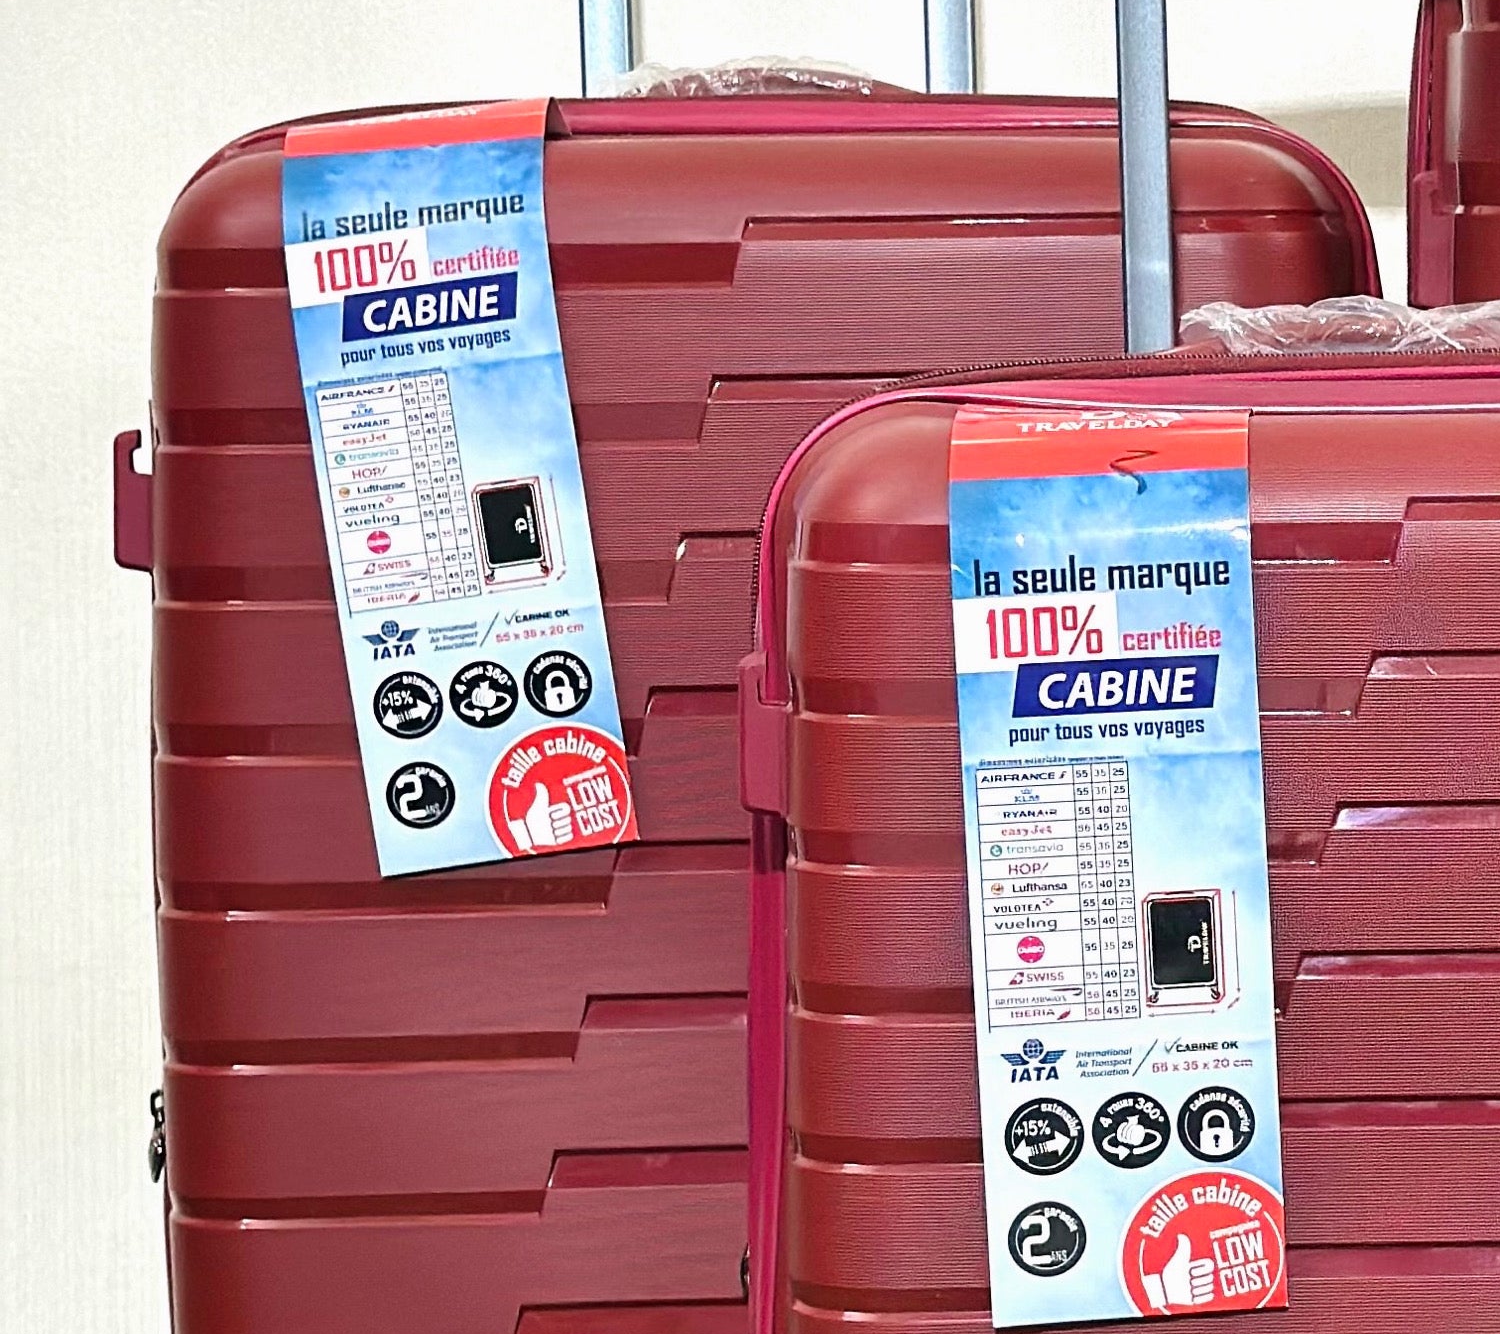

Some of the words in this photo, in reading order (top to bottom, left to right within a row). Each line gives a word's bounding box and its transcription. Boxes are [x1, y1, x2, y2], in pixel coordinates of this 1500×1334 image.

[303, 211, 326, 242] la
[336, 201, 408, 237] seule
[418, 193, 525, 227] marque
[314, 239, 416, 293] 100%
[433, 245, 520, 278] certifiée
[362, 284, 500, 333] CABINE
[340, 347, 376, 369] pour
[381, 342, 414, 359] tous
[418, 339, 445, 354] vos
[450, 329, 511, 353] voyages
[1017, 418, 1174, 433] TRAVELDAY
[974, 559, 1001, 596] la
[1013, 554, 1096, 594] seule
[1107, 560, 1230, 595] marque
[986, 604, 1102, 659] 100%
[1122, 620, 1222, 652] certifiée
[373, 643, 416, 661] IATA
[1038, 666, 1197, 710] CABINE
[1009, 726, 1050, 747] pour
[1055, 722, 1093, 740] tous
[1098, 724, 1128, 738] vos
[1135, 718, 1205, 739] voyages
[501, 746, 542, 788] taille
[981, 772, 1055, 783] AIRFRANCE
[396, 774, 427, 819] 2
[567, 775, 613, 812] LOW
[1097, 805, 1110, 814] 40
[575, 802, 622, 836] COST
[1012, 882, 1068, 893] Lufthansa
[1101, 897, 1115, 906] 40
[994, 917, 1058, 932] vueling
[1084, 917, 1097, 926] 55
[1102, 916, 1116, 925] 40
[1026, 972, 1065, 982] SWISS
[1104, 970, 1117, 979] 40
[1221, 1041, 1239, 1049] OK
[1010, 1066, 1059, 1083] IATA
[1140, 1188, 1188, 1238] taille
[1192, 1178, 1262, 1217] cabine
[1021, 1215, 1052, 1265] 2
[1213, 1230, 1264, 1269] LOW
[1220, 1259, 1271, 1297] COST
